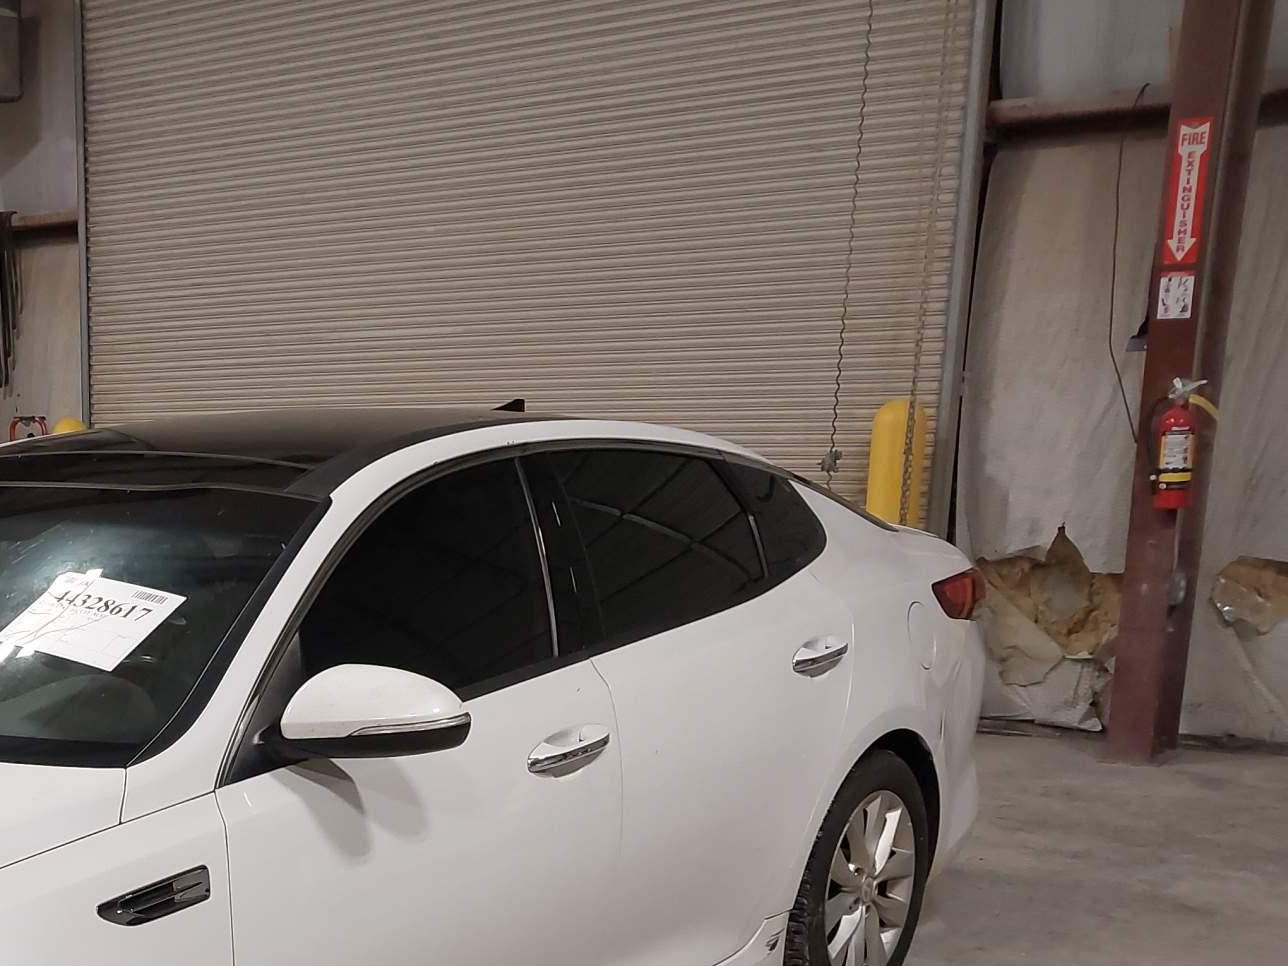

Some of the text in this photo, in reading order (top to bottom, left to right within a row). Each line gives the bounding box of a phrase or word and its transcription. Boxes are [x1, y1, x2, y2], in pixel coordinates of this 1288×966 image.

[1182, 131, 1207, 146] FIRE
[1176, 151, 1195, 253] EXTINGUISHER
[54, 590, 152, 622] 44328617
